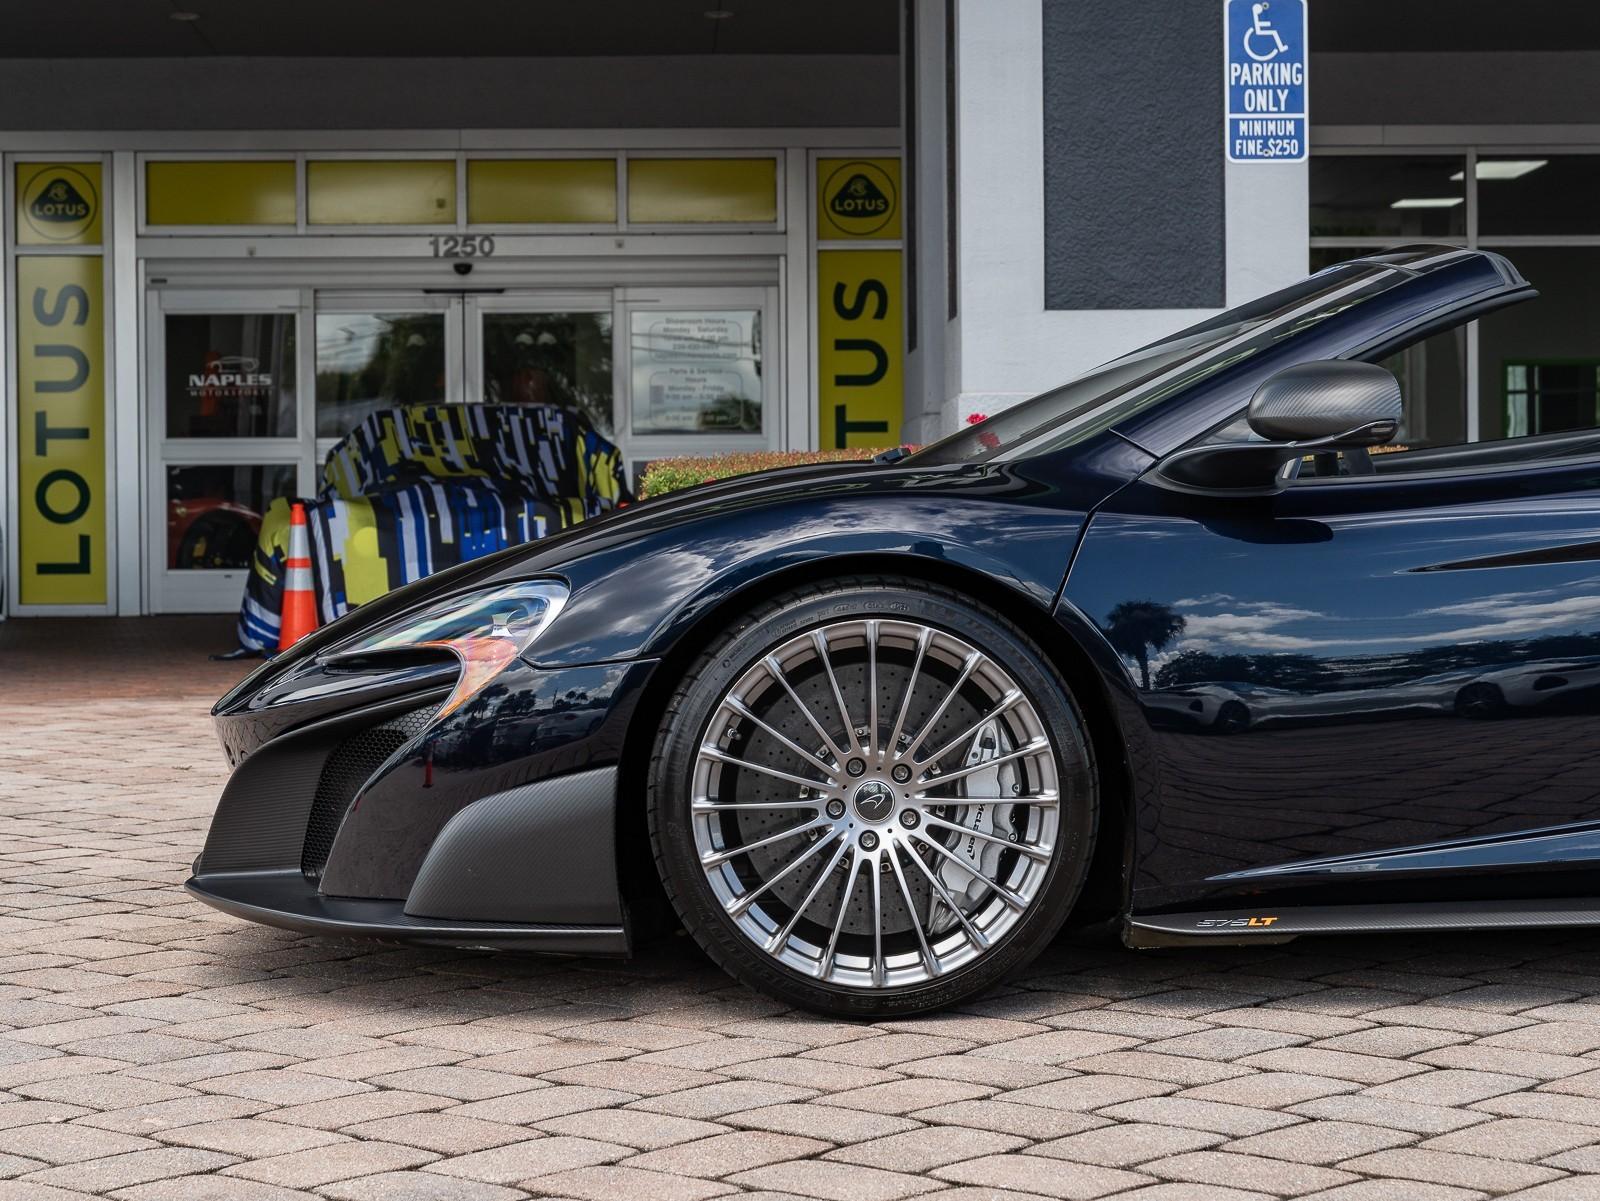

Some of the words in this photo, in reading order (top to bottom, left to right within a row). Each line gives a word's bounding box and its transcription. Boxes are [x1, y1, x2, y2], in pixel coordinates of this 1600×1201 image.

[1230, 62, 1303, 86] PARKING
[1244, 88, 1289, 112] ONLY
[1239, 120, 1295, 137] MINIMUM
[1235, 139, 1264, 156] FINE
[1267, 137, 1299, 157] $250
[35, 203, 86, 216] LOTUS
[835, 199, 886, 212] LOTUS
[429, 235, 495, 258] 1250
[833, 278, 889, 450] TUS
[189, 373, 273, 386] NAPLES
[33, 283, 91, 575] LOTUS
[966, 803, 986, 853] McLaen
